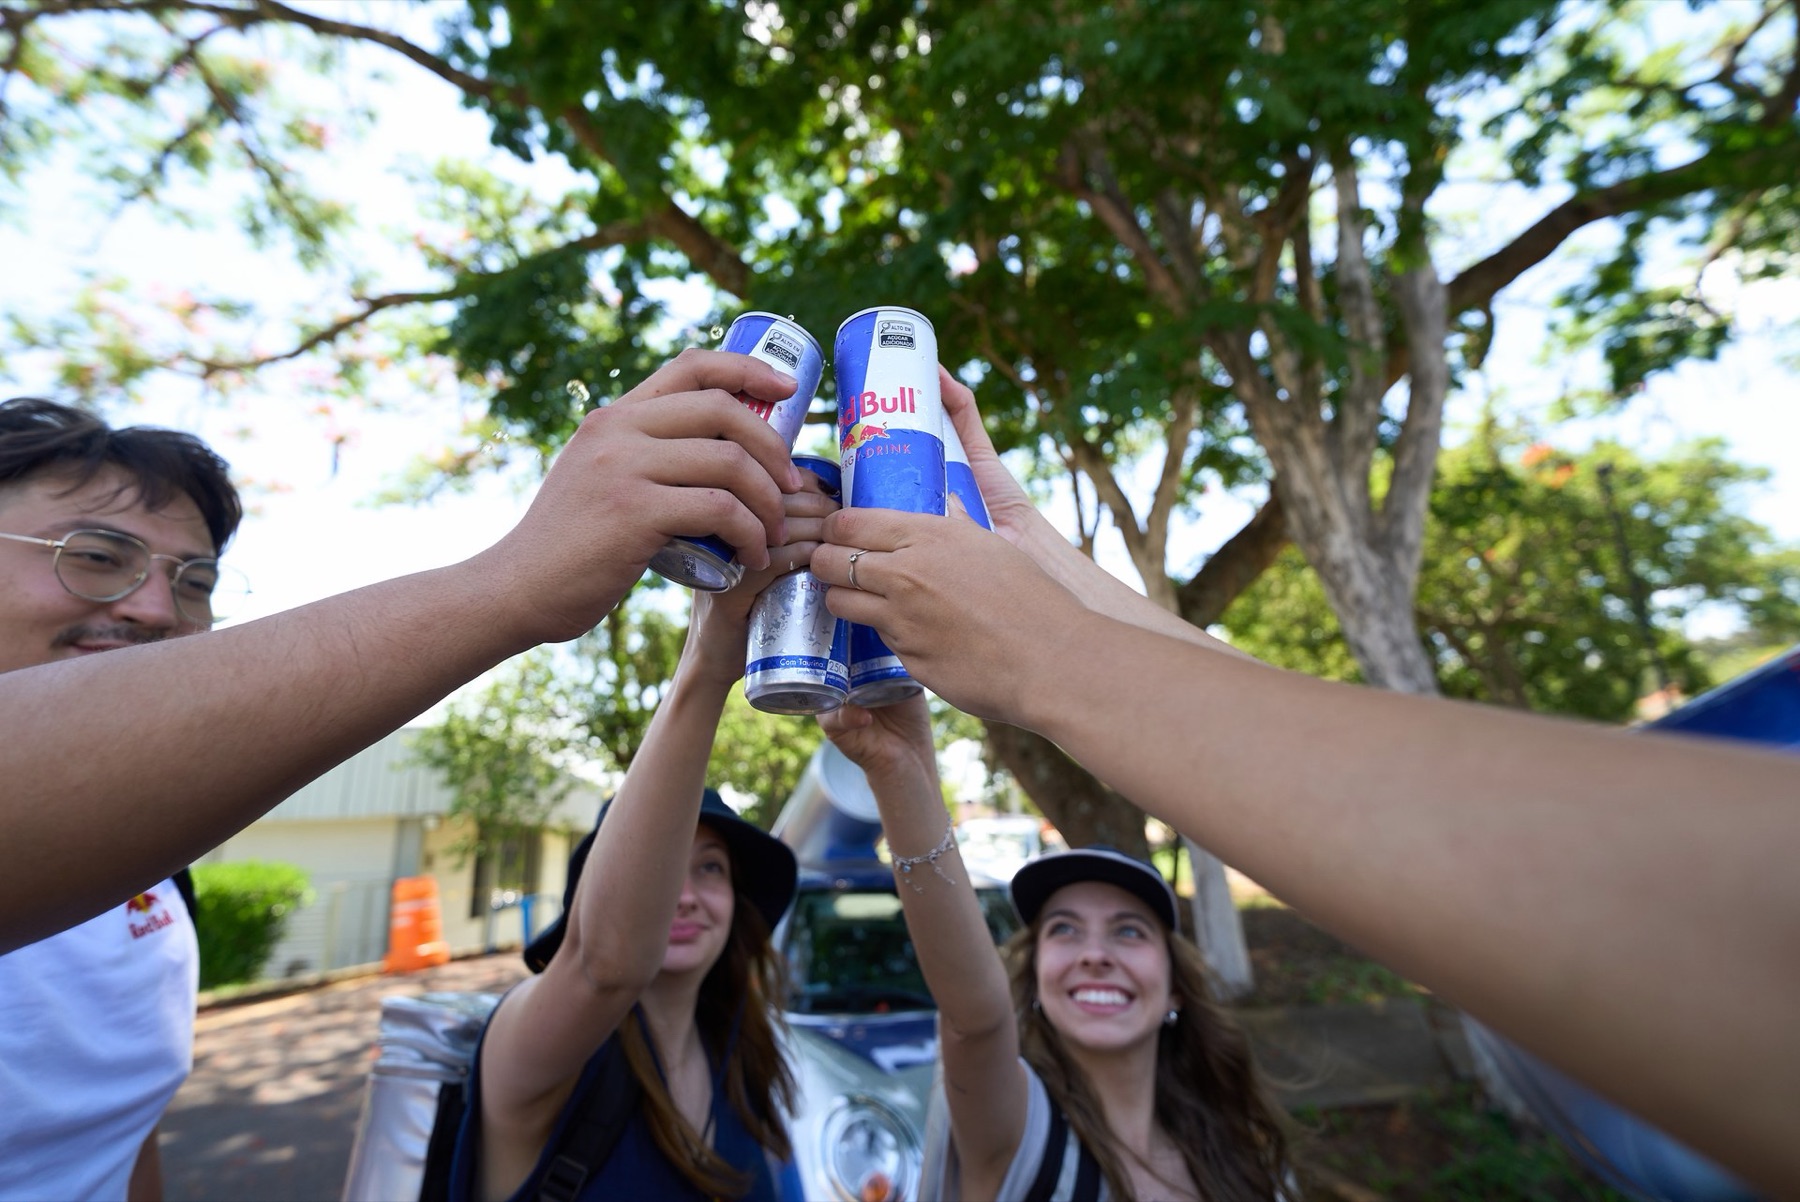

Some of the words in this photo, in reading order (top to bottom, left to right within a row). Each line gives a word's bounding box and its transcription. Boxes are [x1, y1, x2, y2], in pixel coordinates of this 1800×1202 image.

[780, 337, 793, 348] ALTO
[882, 340, 914, 348] ADICIONADO
[765, 346, 796, 368] ADICIONADO
[860, 386, 915, 418] Bull
[865, 444, 911, 459] DRINK
[801, 580, 829, 593] ENE
[780, 658, 797, 666] Com
[829, 660, 844, 674] 250
[129, 916, 154, 939] Red
[149, 909, 174, 931] Bull
